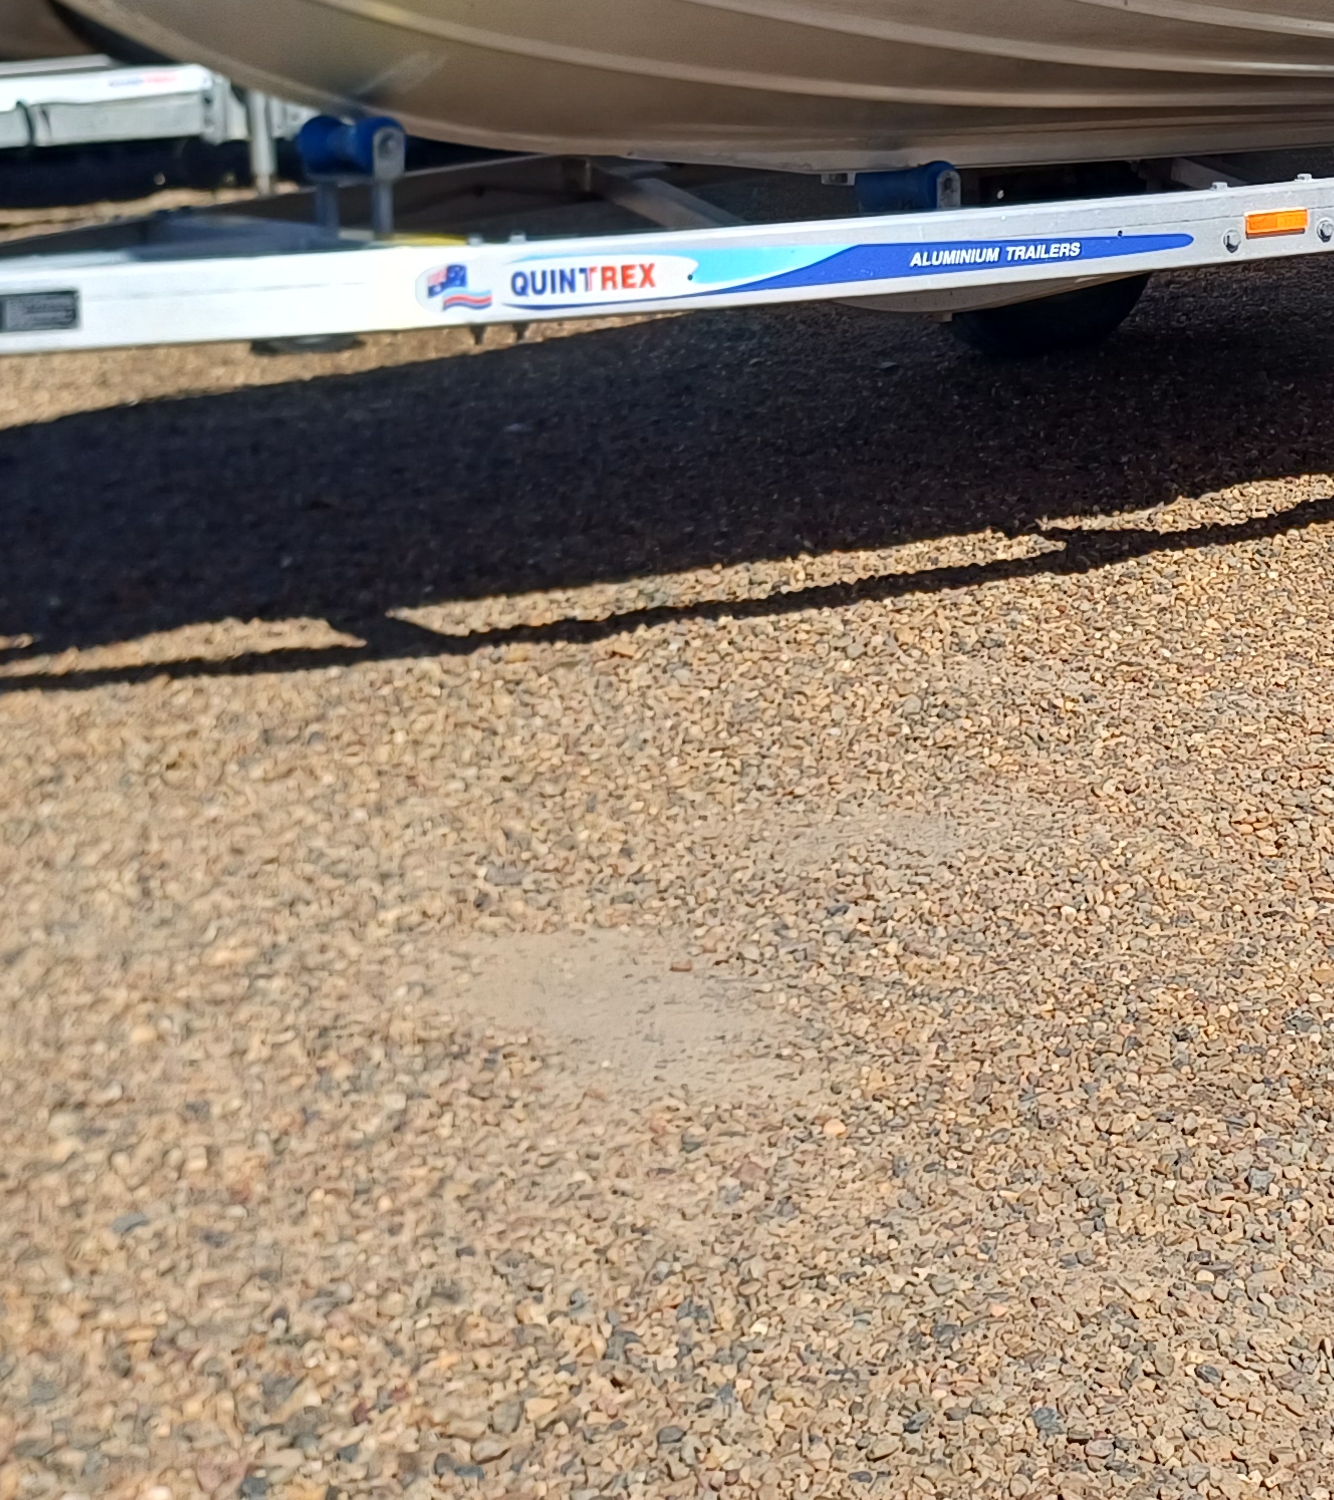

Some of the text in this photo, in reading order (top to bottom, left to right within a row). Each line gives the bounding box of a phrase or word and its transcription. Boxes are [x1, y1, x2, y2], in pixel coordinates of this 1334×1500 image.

[910, 241, 1081, 268] ALUMINIUM TRAILERS
[511, 263, 657, 297] QUINTREX
